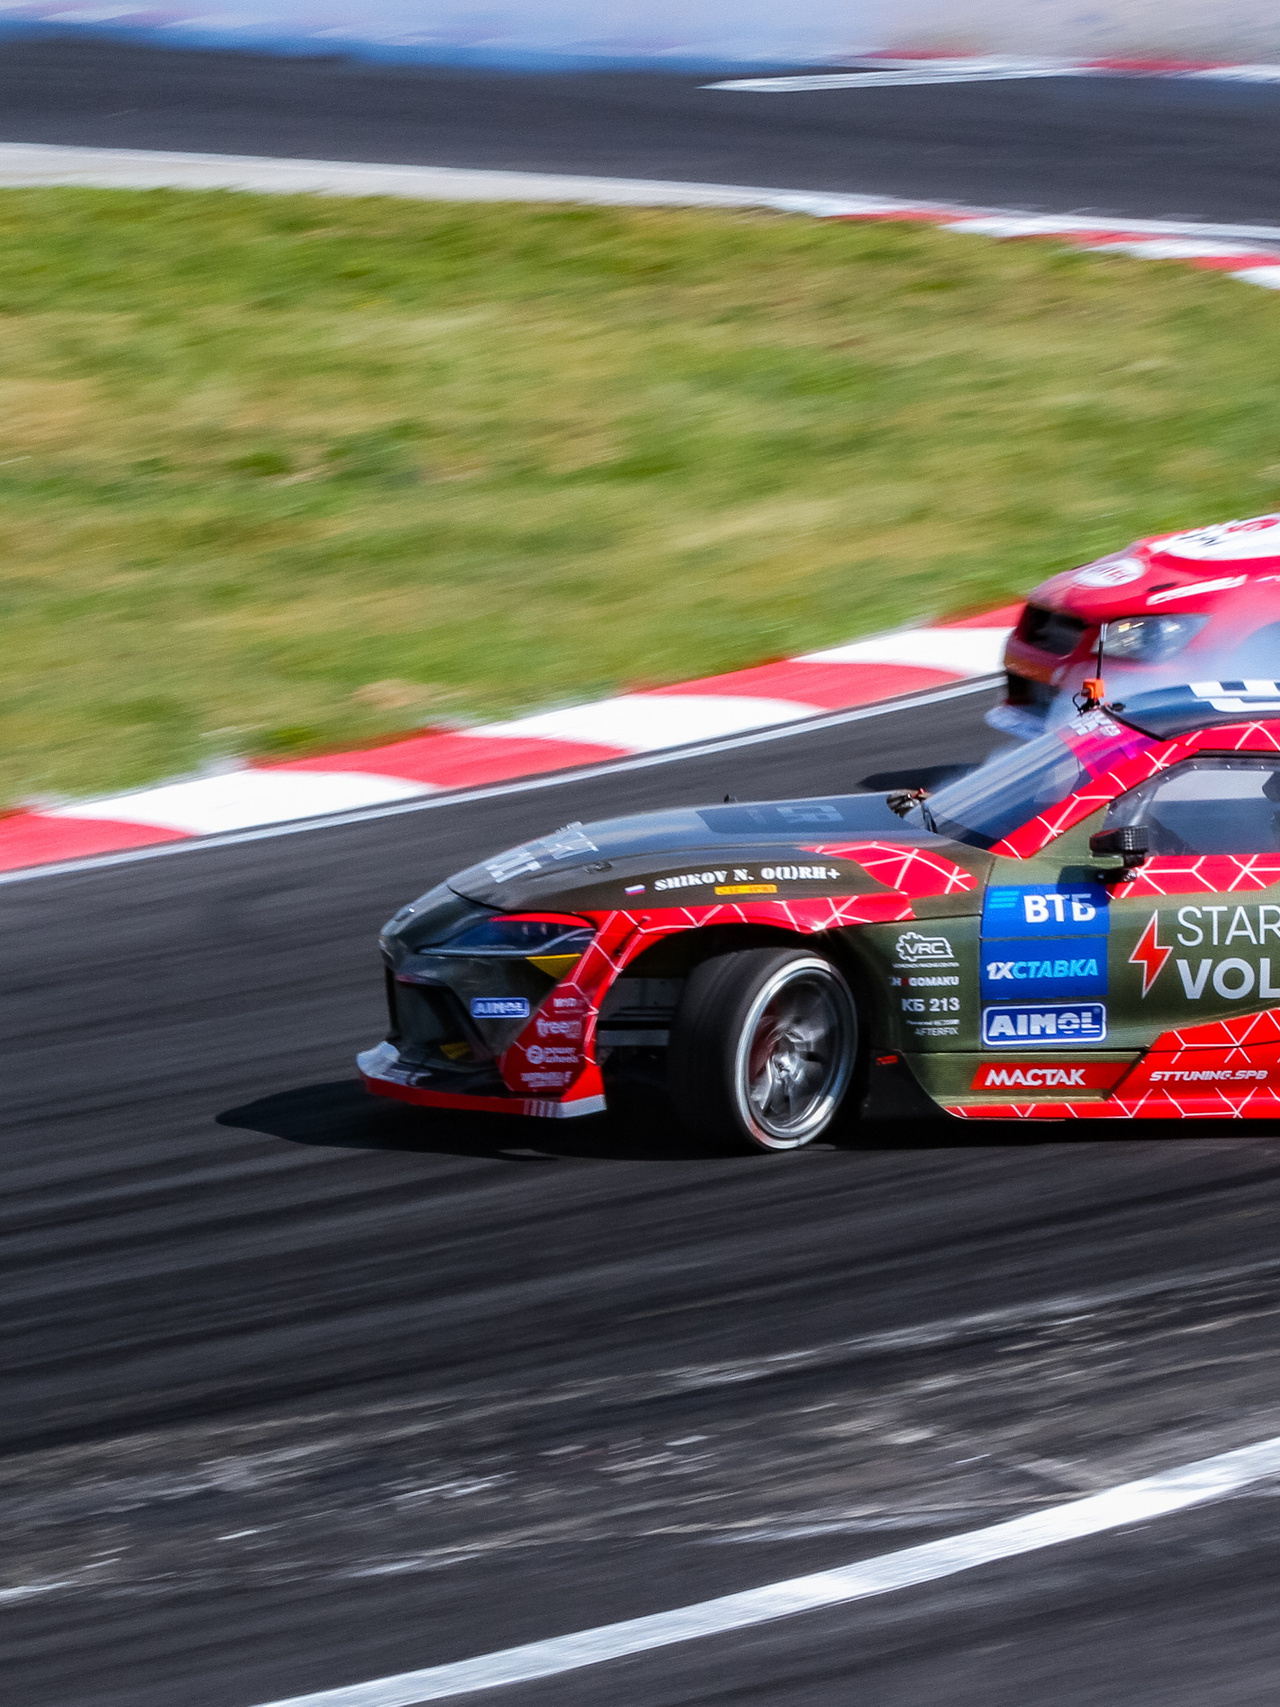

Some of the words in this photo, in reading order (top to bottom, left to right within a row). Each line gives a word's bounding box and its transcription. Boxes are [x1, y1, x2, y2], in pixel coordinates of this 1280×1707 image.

[654, 870, 728, 891] SHIKOV
[733, 869, 754, 882] N.
[1023, 893, 1097, 924] ВТБ
[904, 942, 945, 955] VRC
[929, 997, 960, 1012] 213
[988, 1011, 1101, 1037] AIMOL
